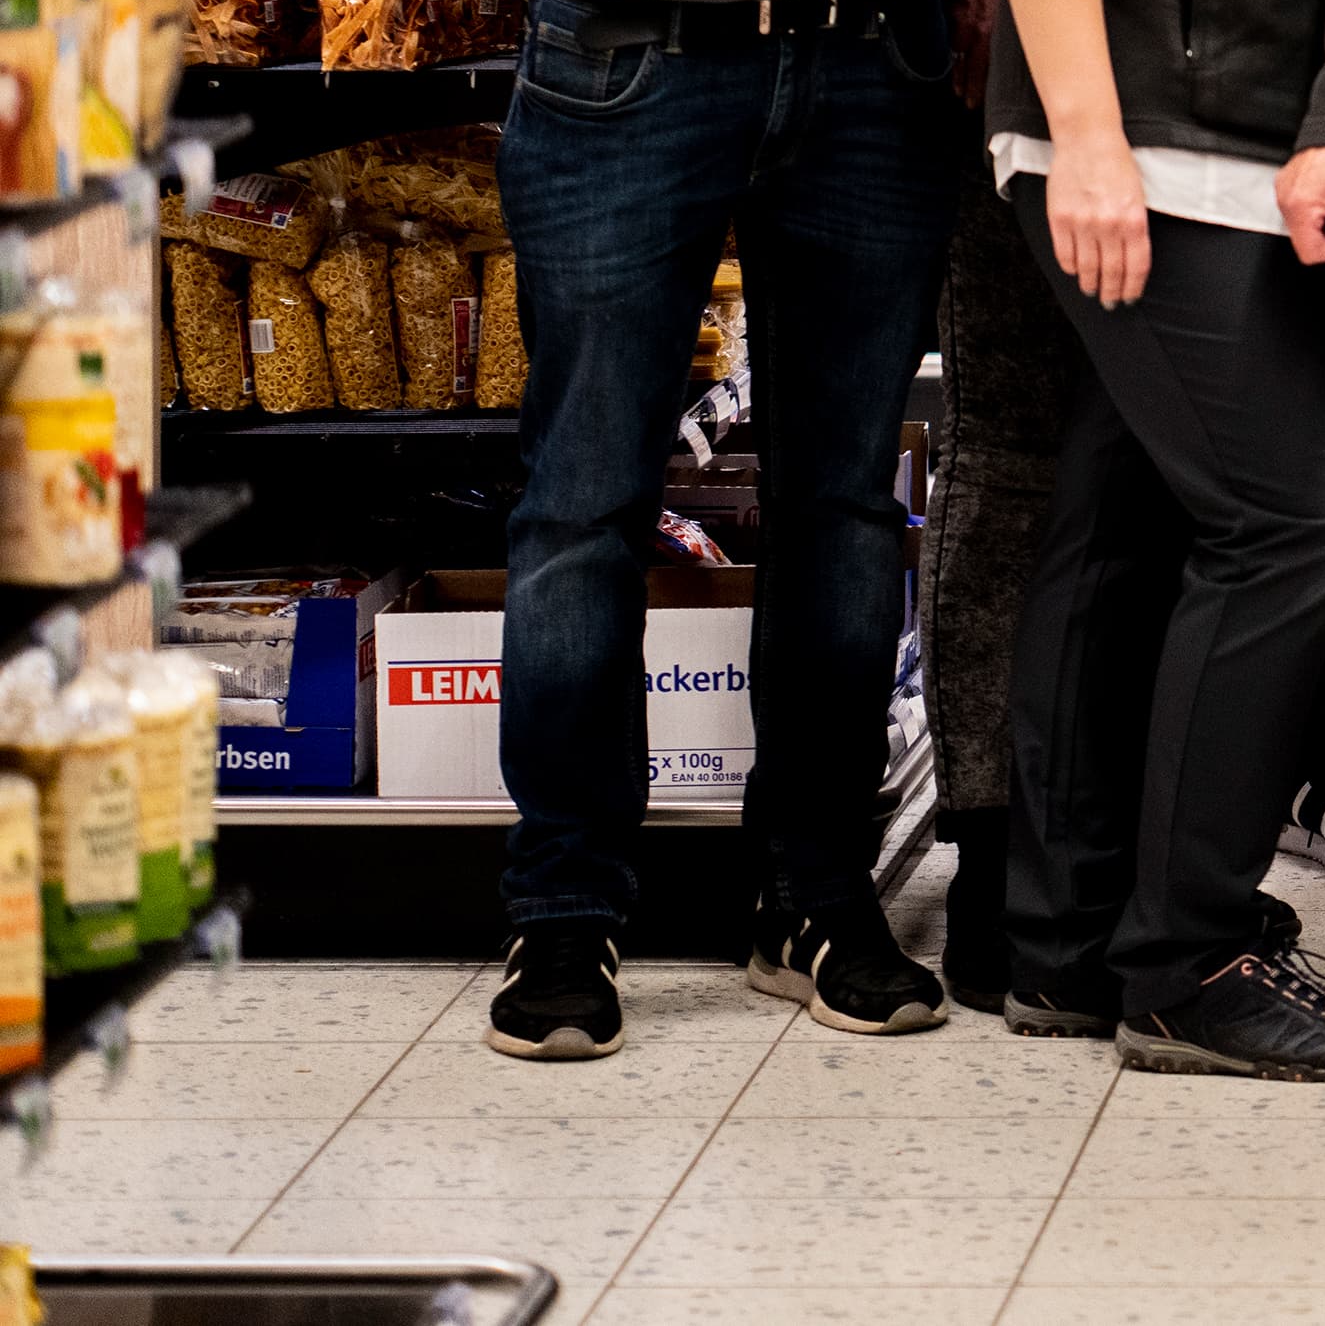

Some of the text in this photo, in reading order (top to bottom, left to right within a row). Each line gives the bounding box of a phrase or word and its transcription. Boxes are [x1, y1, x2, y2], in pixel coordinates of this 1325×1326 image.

[411, 670, 501, 702] LEIM
[662, 757, 672, 768] x
[679, 754, 723, 771] 100g
[672, 774, 694, 782] EAN
[697, 773, 709, 782] 40
